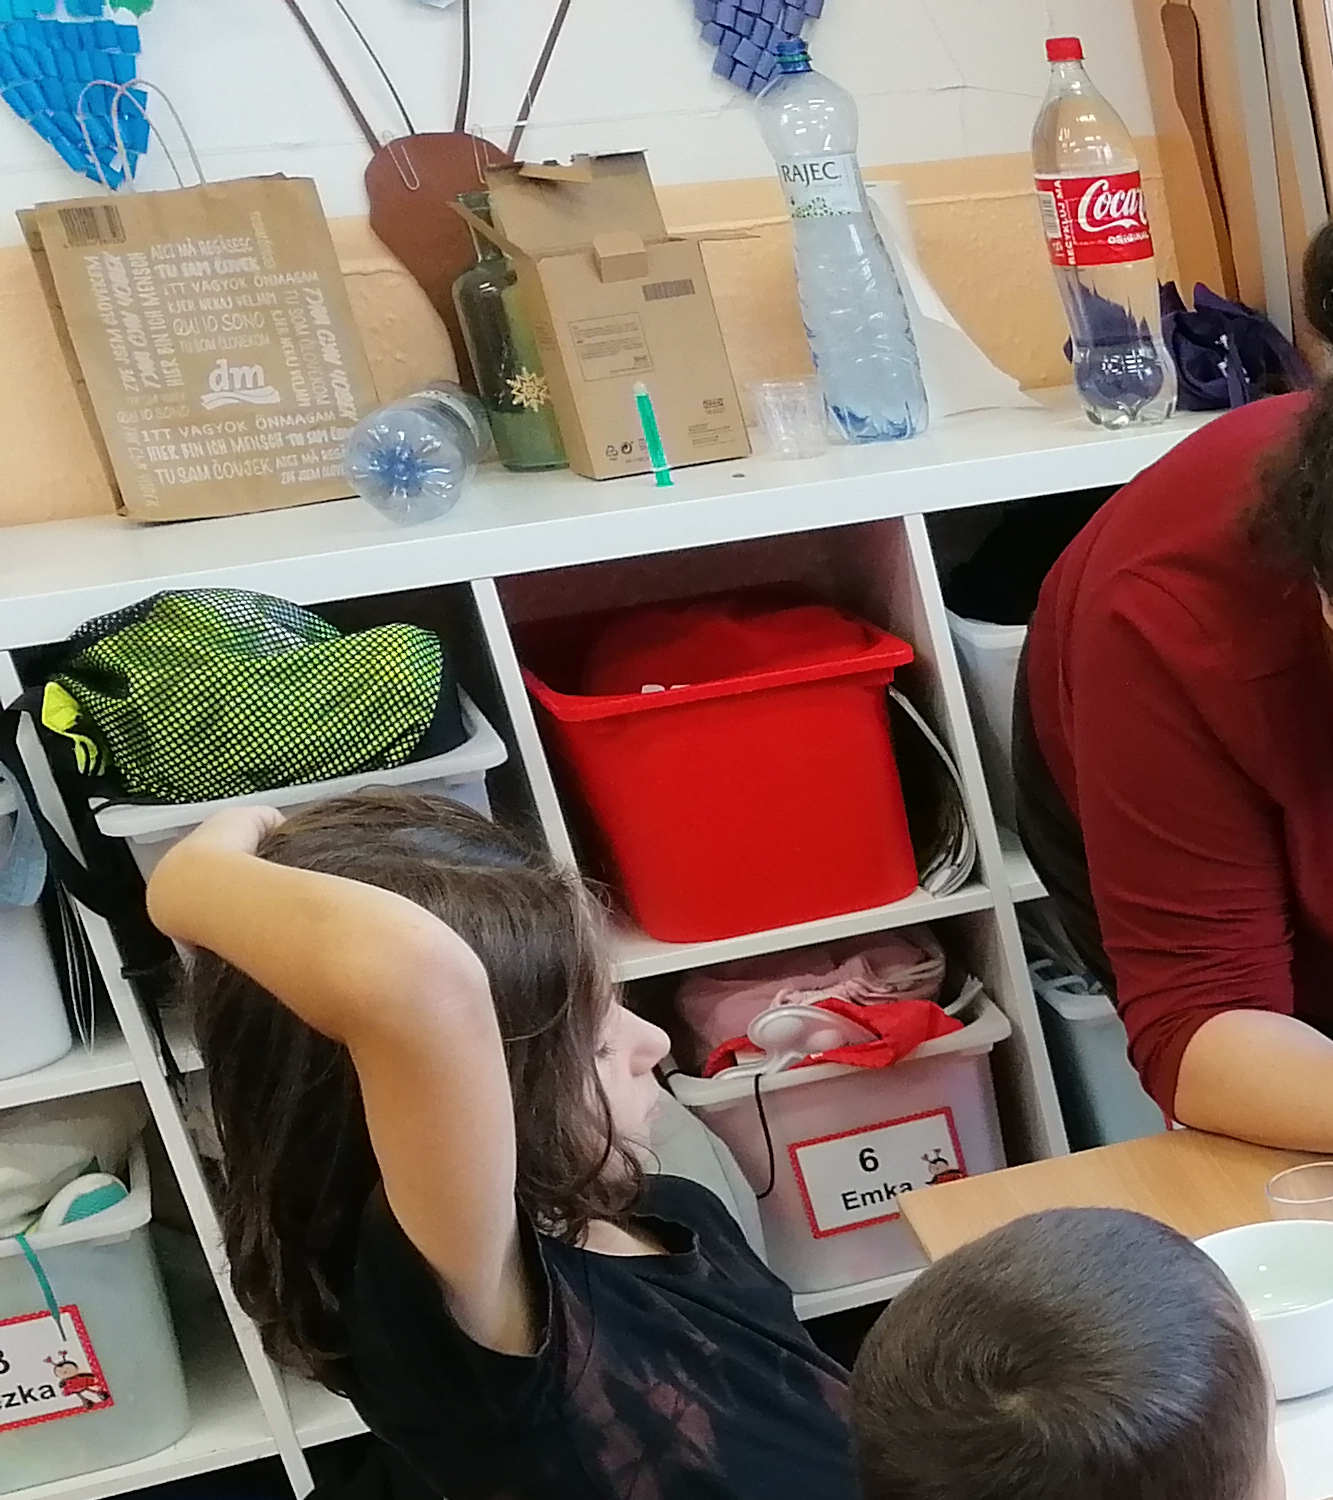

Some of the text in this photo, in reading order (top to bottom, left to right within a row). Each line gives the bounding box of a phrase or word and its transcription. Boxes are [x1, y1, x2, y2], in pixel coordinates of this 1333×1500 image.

[781, 161, 839, 187] RAJEC
[126, 252, 161, 307] MENSCH
[163, 282, 186, 296] ITT
[191, 277, 248, 293] VAGYOK
[143, 310, 167, 331] ICH
[221, 311, 265, 331] SONO
[160, 357, 185, 387] HIER
[208, 358, 266, 392] dm
[141, 411, 336, 443] ITT VAGYOK ÖNMAGAM
[146, 432, 284, 463] HIER BIN ICH MENSCH
[154, 457, 274, 485] TU SAM ČOVJEK
[859, 1148, 879, 1173] 6
[0, 1384, 56, 1410] zka
